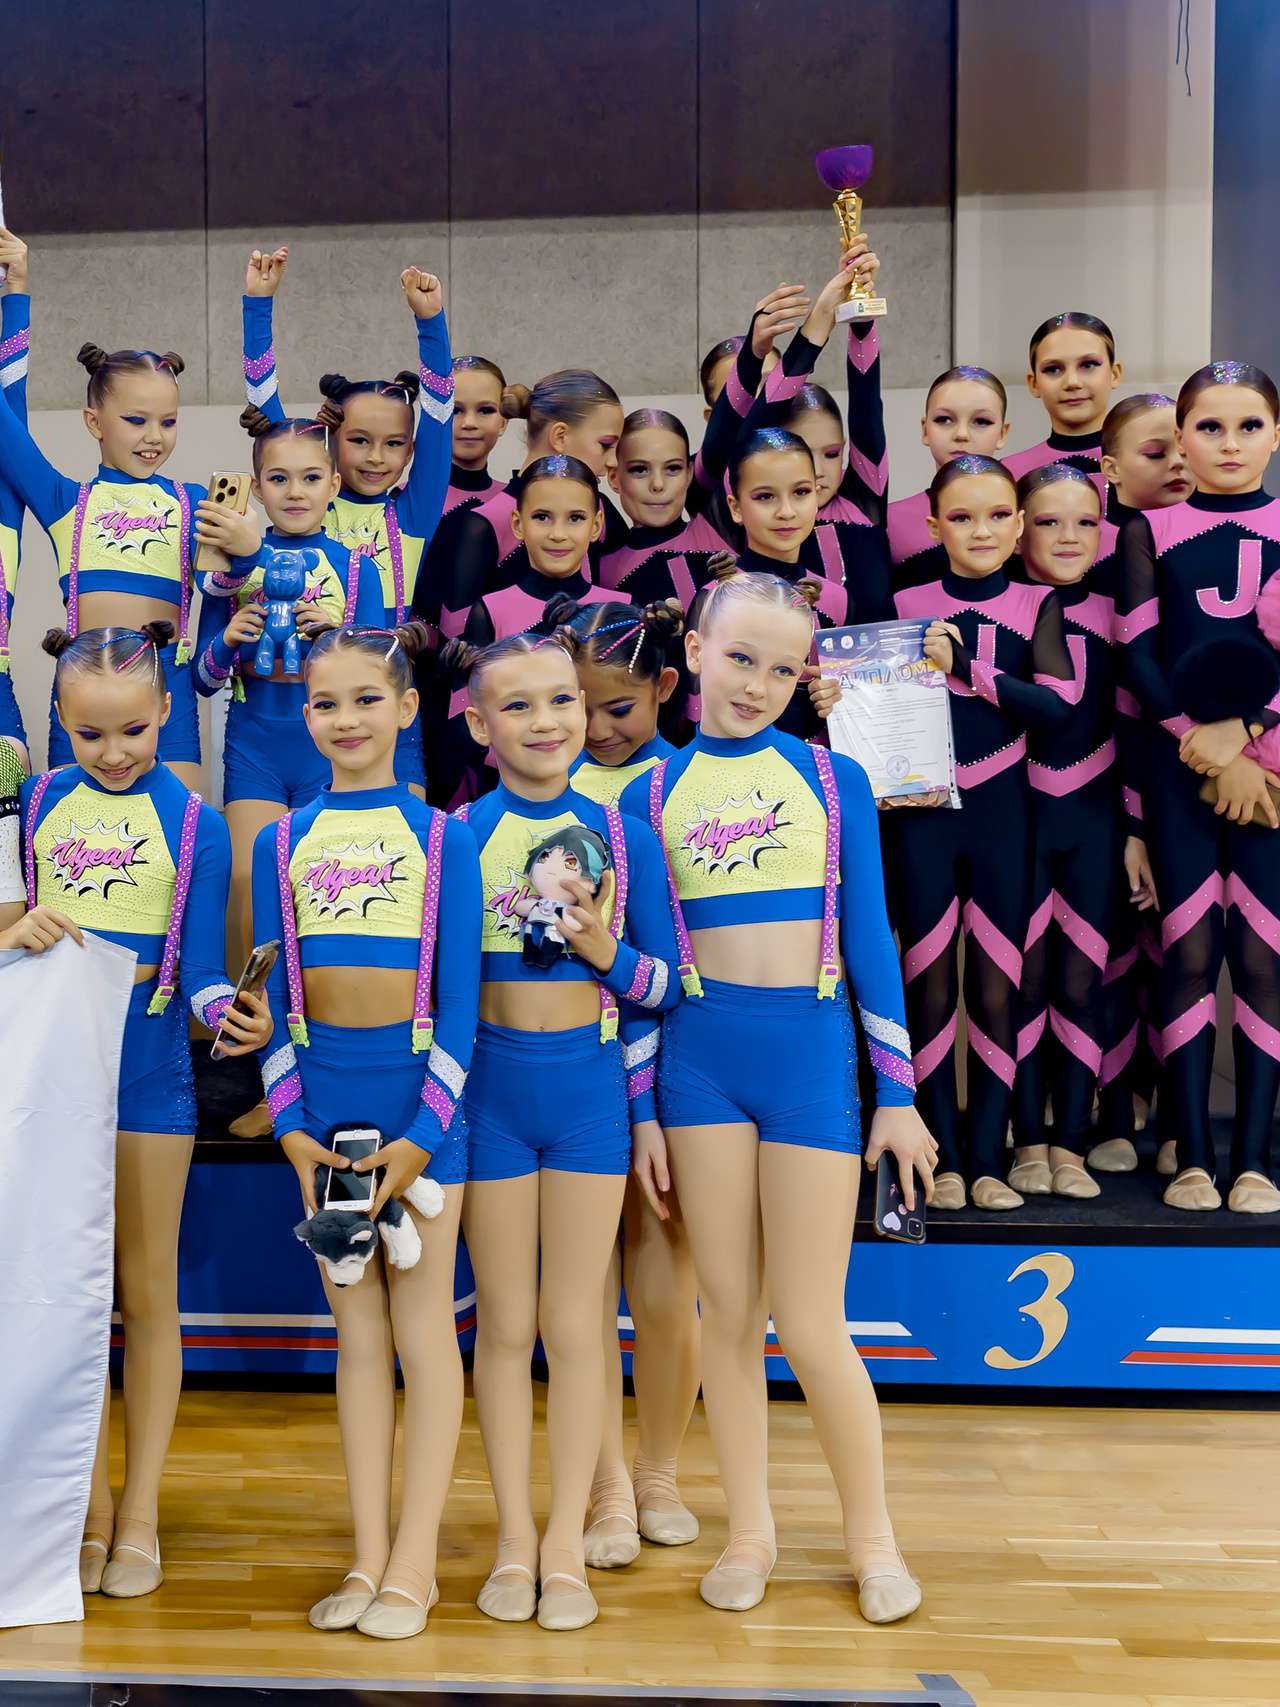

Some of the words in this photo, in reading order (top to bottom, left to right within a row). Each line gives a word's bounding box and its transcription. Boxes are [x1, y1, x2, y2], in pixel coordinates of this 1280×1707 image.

[95, 510, 168, 538] Идеал
[1196, 539, 1262, 618] J
[838, 662, 930, 690] ДИПЛОМ
[682, 813, 777, 859] Идеал
[51, 838, 136, 879] Идеал
[303, 859, 395, 903] Идеал
[983, 1252, 1075, 1370] 3
